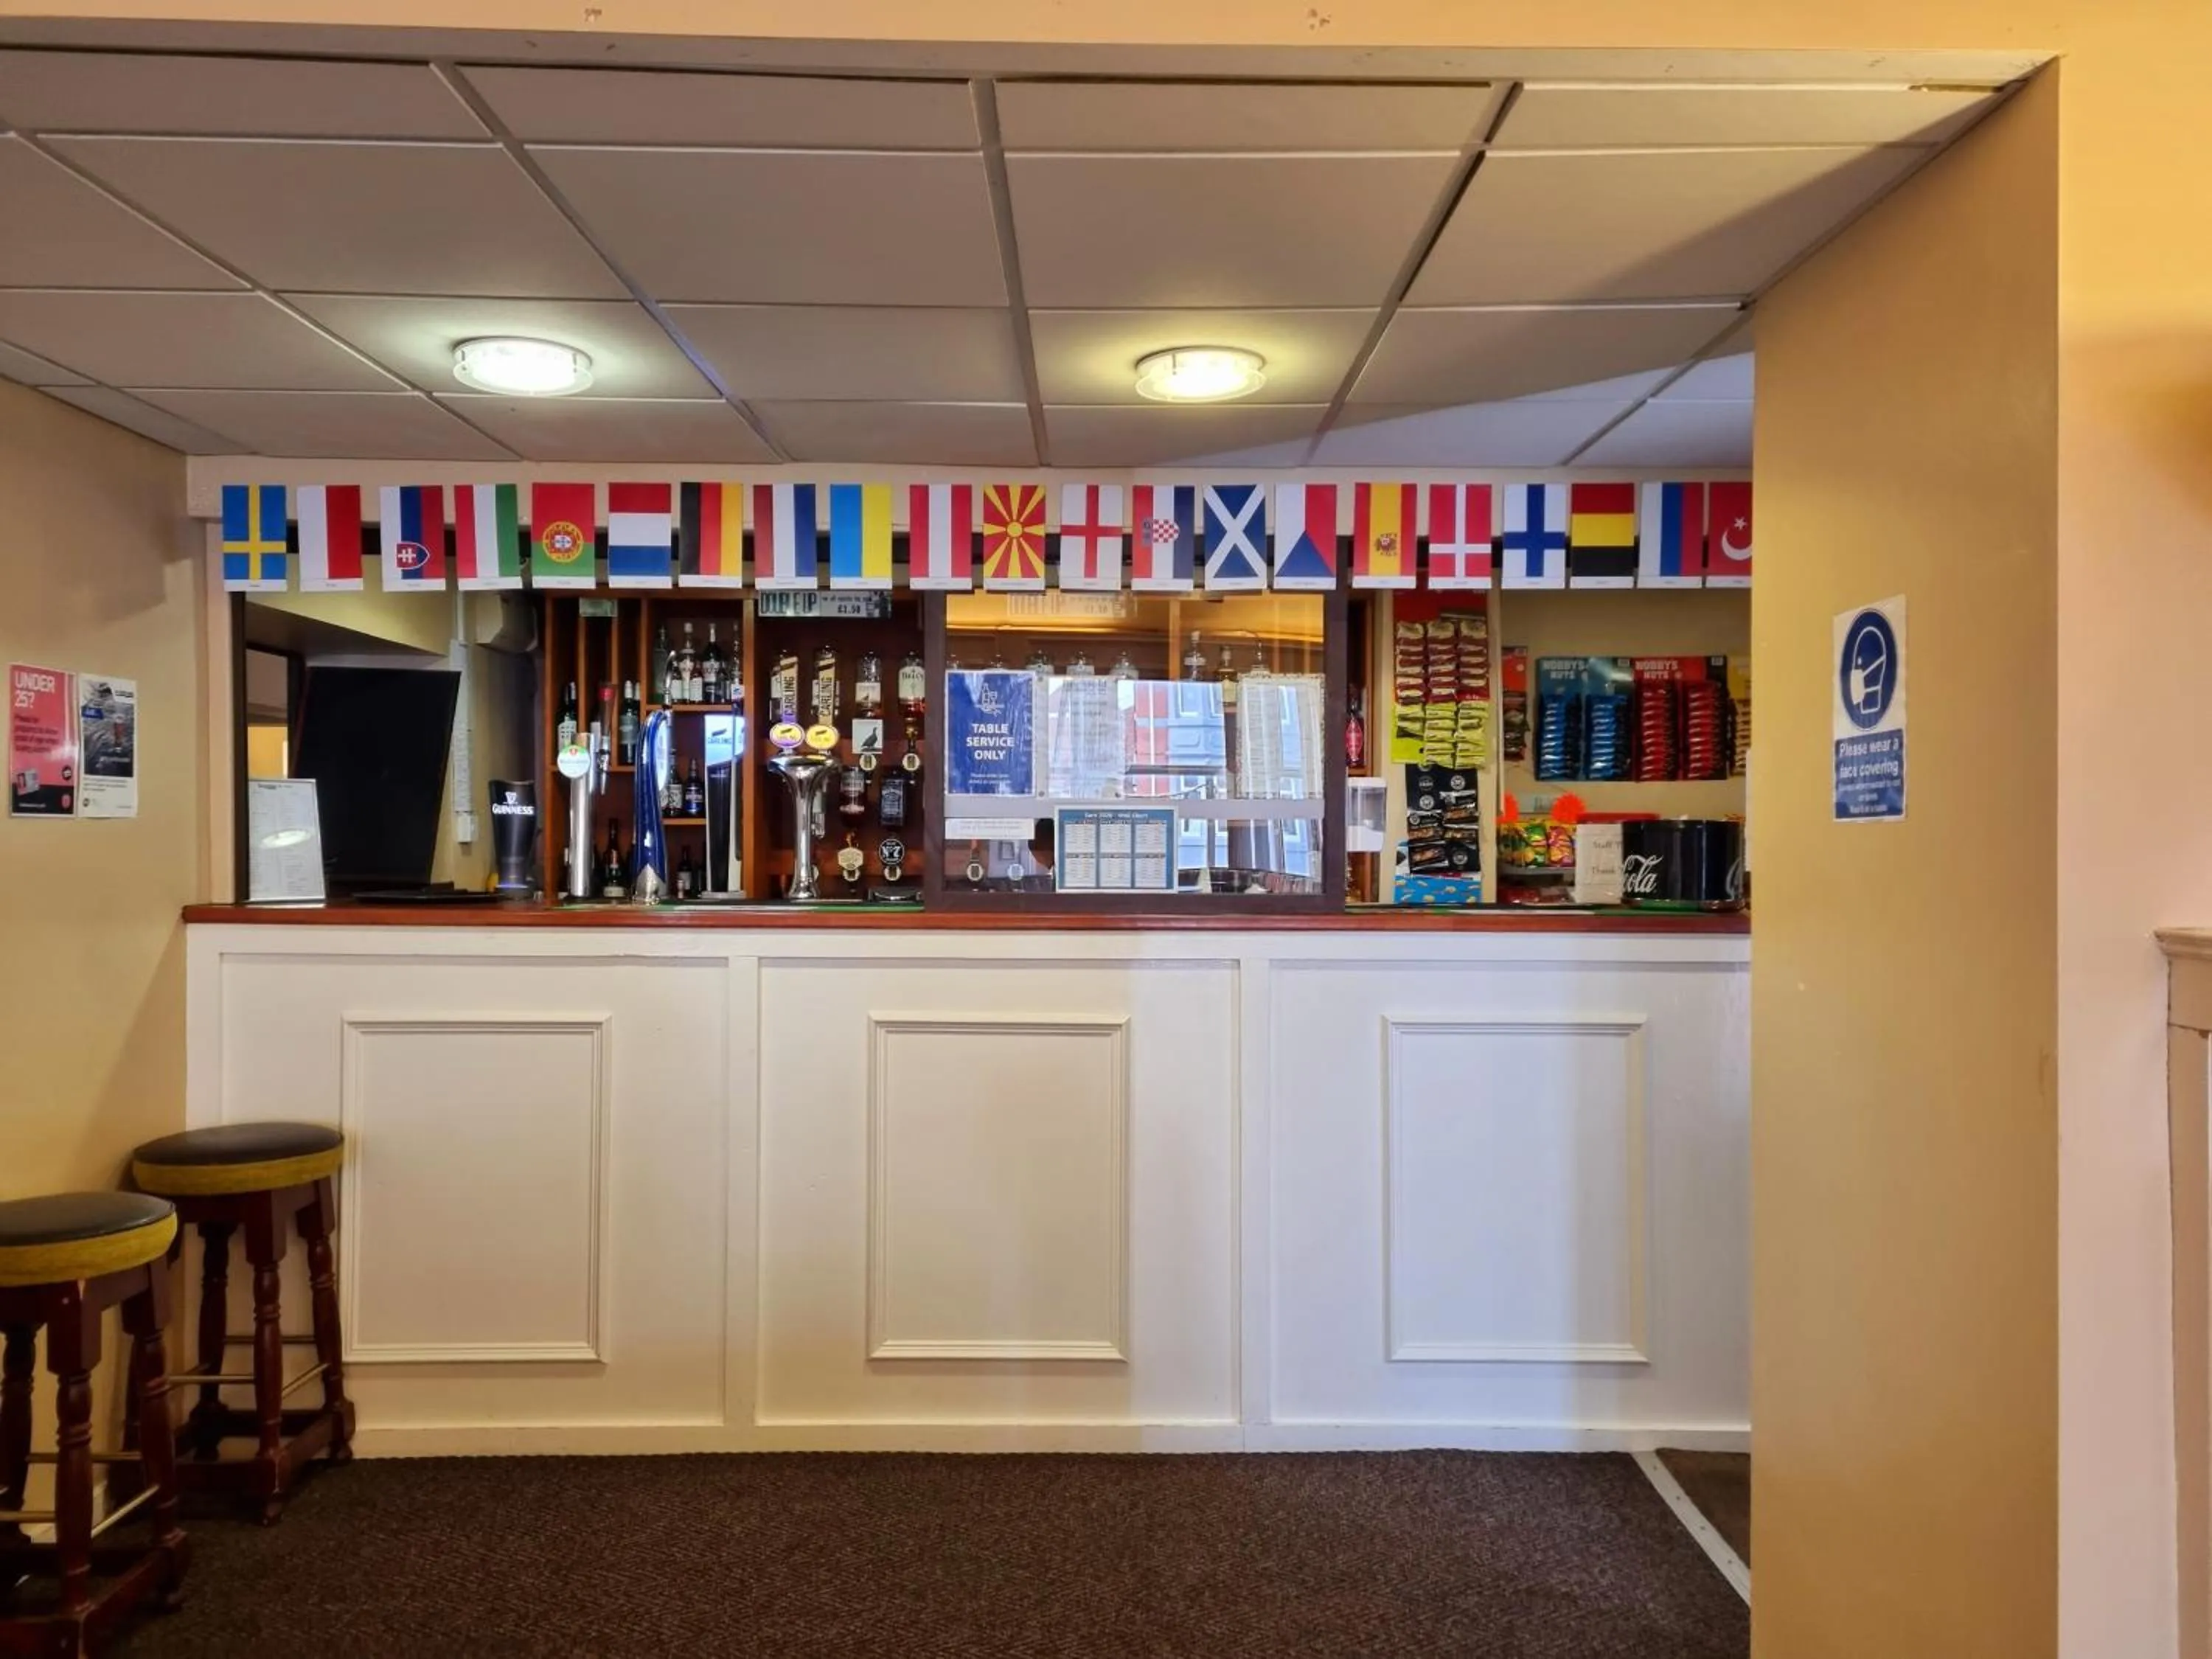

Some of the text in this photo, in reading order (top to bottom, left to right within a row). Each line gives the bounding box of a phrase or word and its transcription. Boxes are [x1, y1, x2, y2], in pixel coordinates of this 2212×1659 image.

[15, 672, 55, 693] UNDER
[15, 690, 35, 709] 25?
[971, 723, 1009, 734] TABLE
[966, 737, 1015, 747] SERVICE
[1840, 738, 1899, 758] Please wear a
[974, 750, 1006, 760] ONLY
[1859, 758, 1899, 777] covering
[492, 803, 535, 815] GUINNESS
